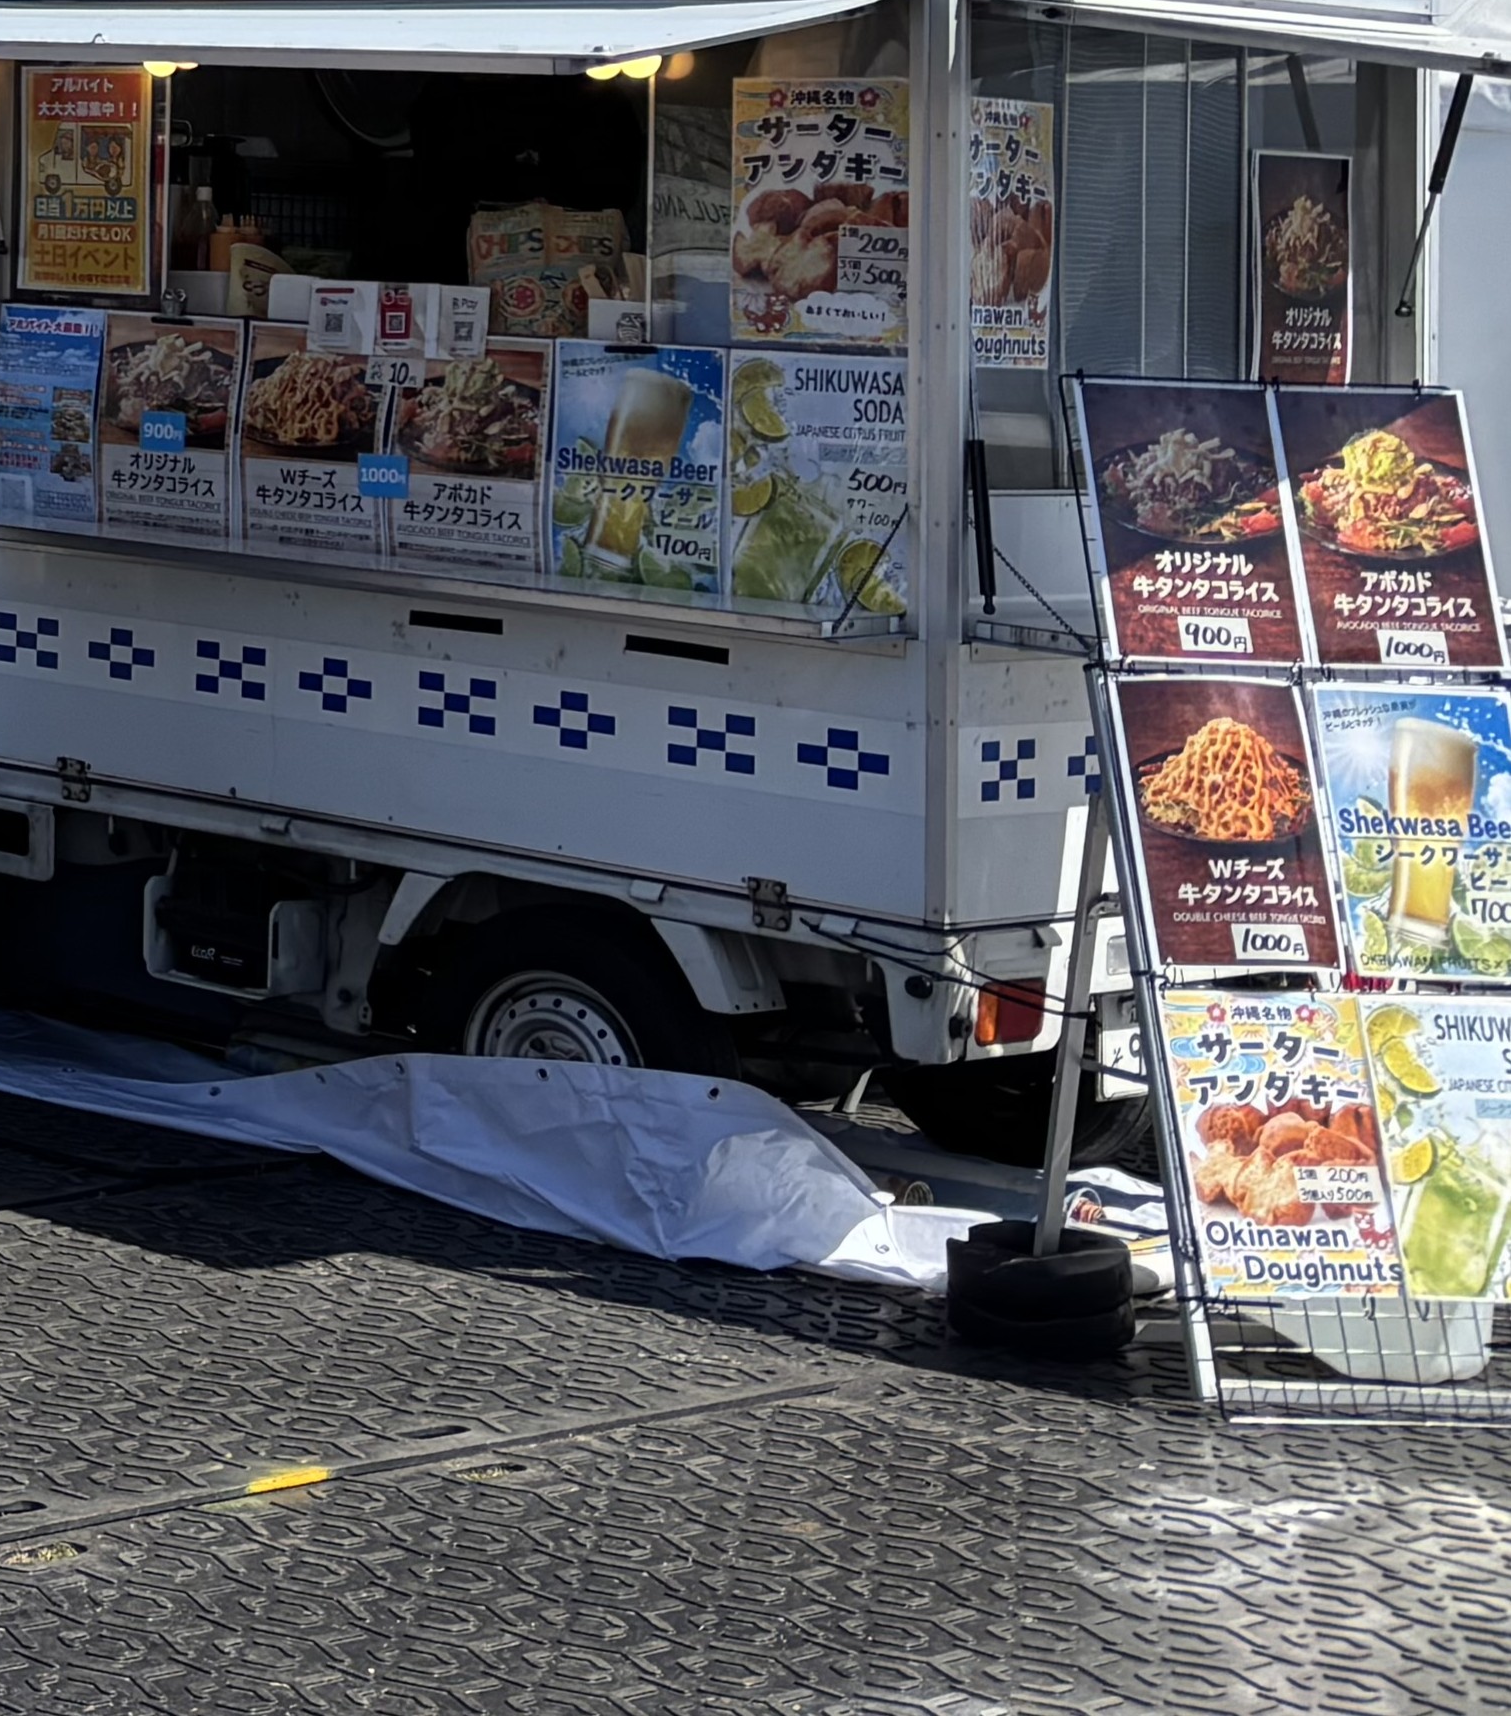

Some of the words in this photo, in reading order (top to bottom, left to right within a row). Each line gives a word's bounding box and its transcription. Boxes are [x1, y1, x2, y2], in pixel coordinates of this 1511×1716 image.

[51, 78, 114, 93] アルバイト
[790, 90, 855, 106] 沖縄名物
[757, 114, 892, 145] サーター
[743, 150, 904, 183] アンダギー
[971, 169, 1046, 202] ンダギー
[34, 244, 135, 270] 土日イベント
[1285, 307, 1332, 326] オリジナル
[1272, 331, 1342, 350] 牛タンタコライス
[795, 368, 905, 396] SHIKUWASA
[853, 399, 905, 424] SODA
[143, 422, 182, 441] 900円
[130, 453, 195, 474] オリジナル
[361, 468, 406, 484] 1000円
[558, 448, 664, 477] Shekwasa
[670, 458, 718, 482] Beer
[112, 470, 215, 497] 牛タンタコライス
[280, 468, 337, 489] Wチーズ
[848, 468, 906, 495] 500円
[256, 485, 364, 513] 牛タンタコライス
[433, 483, 493, 505] アボカド
[582, 480, 712, 506] シークワーサー
[404, 501, 522, 530] 牛タンタコライス
[660, 509, 713, 530] ビール
[656, 534, 711, 561] 700円
[1155, 550, 1254, 576] オリジナル
[1133, 575, 1279, 602] 牛タンタコライス
[1360, 570, 1432, 593] アボカド
[1334, 593, 1476, 618] 牛タンタコライス
[1185, 622, 1247, 652] 900円
[1386, 636, 1445, 663] 1000円
[1339, 807, 1463, 838] Shekwasa
[1209, 858, 1285, 881] Wチーズ
[1178, 883, 1318, 908] 牛タンタコライス
[1173, 912, 1210, 922] DOUBLE
[1214, 912, 1246, 922] CHEESE
[1242, 928, 1304, 956] 1000円
[1231, 1005, 1293, 1022] 沖縄名物
[1197, 1031, 1340, 1064] サーター
[1189, 1070, 1359, 1105] アンダギー
[1448, 1078, 1496, 1093] JAPANESE
[1328, 1167, 1369, 1183] 200円
[1205, 1220, 1350, 1248] Okinawan
[1244, 1255, 1403, 1286] Doughnuts
